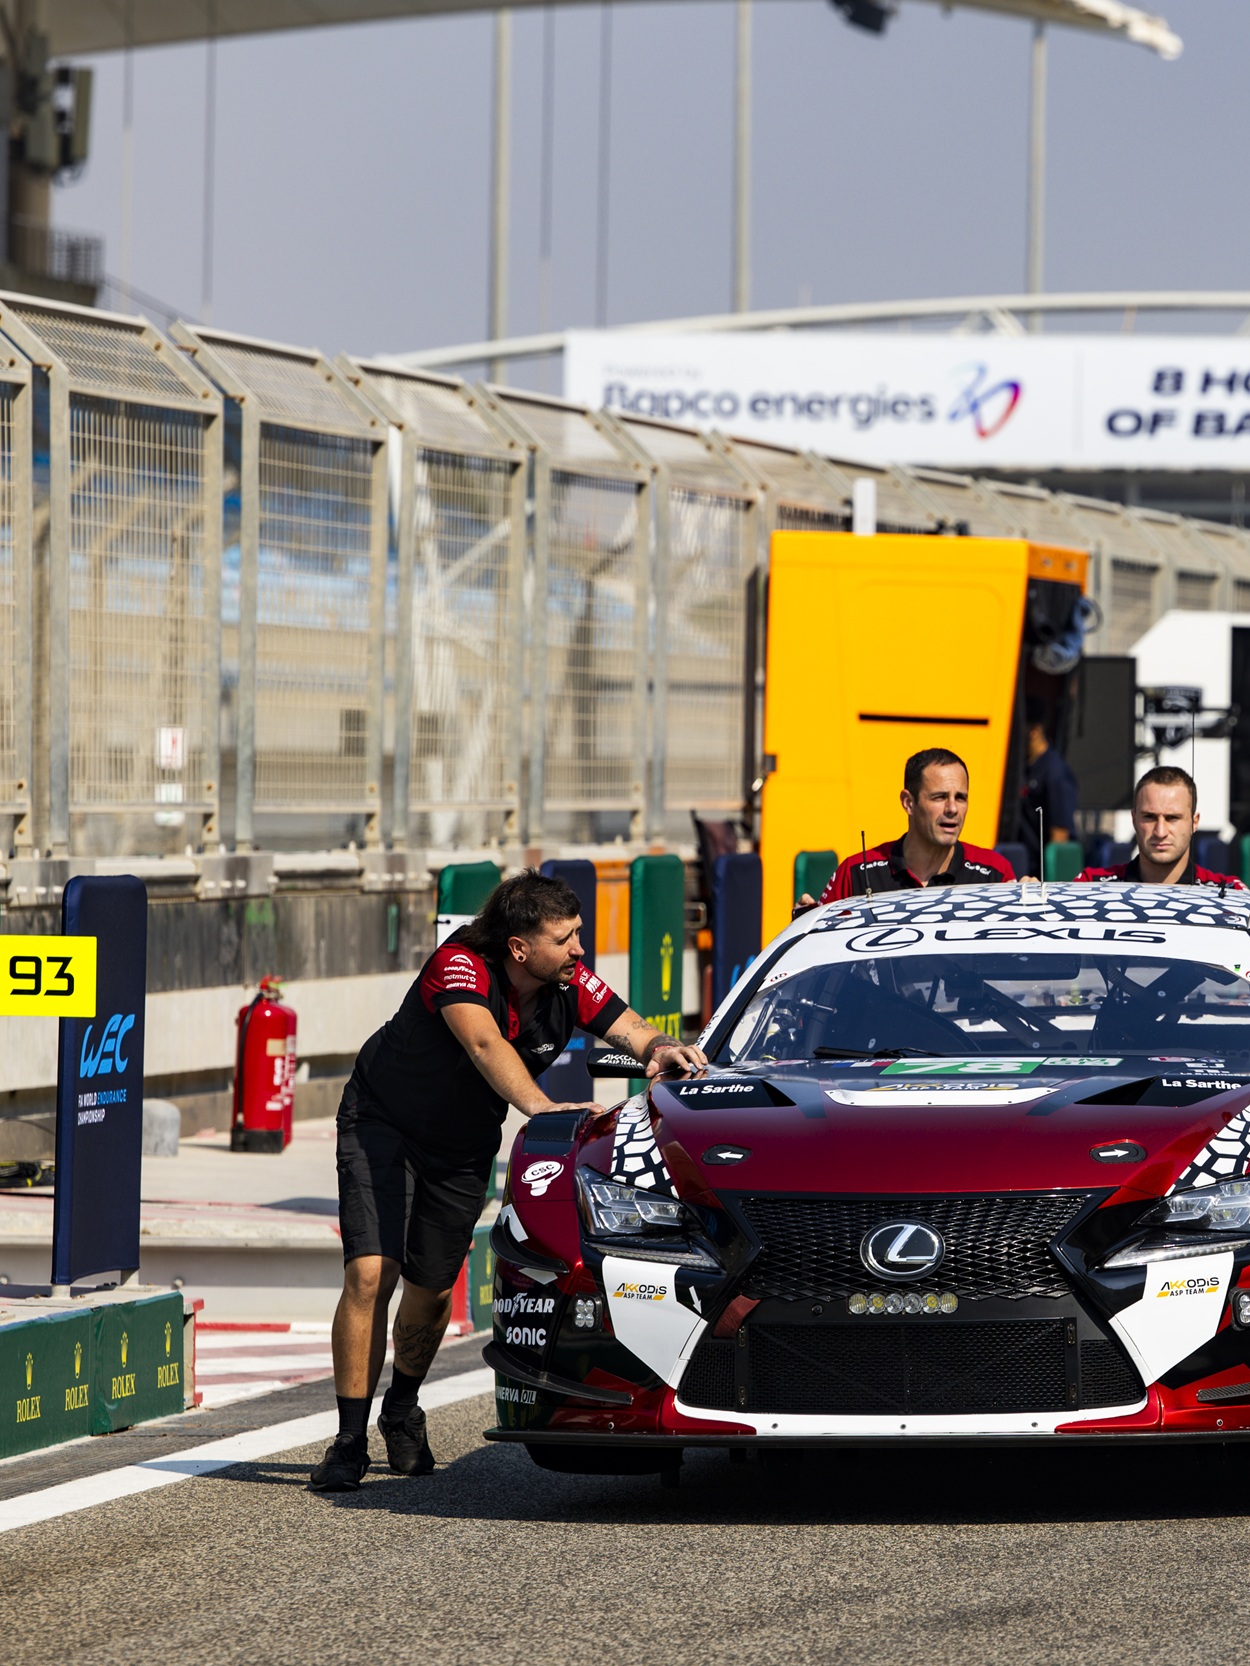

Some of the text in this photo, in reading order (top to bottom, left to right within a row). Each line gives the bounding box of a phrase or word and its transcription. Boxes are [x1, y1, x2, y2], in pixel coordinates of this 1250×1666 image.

[1152, 368, 1184, 396] 8
[603, 382, 935, 431] Bapco energies
[1105, 409, 1175, 438] OF
[934, 927, 1167, 944] LEXUS
[8, 955, 76, 997] 93
[79, 1013, 136, 1078] WEC
[896, 1061, 1023, 1074] 78
[679, 1083, 755, 1096] La Sarthe
[1161, 1078, 1242, 1090] La Sarthe
[84, 1092, 97, 1107] WORLD
[97, 1088, 127, 1106] ENDURANCE
[531, 1164, 555, 1176] CSC
[492, 1296, 555, 1315] OODYEAR
[506, 1326, 547, 1346] SONIC
[111, 1373, 136, 1400] ROLEX
[157, 1362, 180, 1389] ROLEX
[65, 1384, 89, 1411] ROLEX
[521, 1390, 536, 1404] OIL
[16, 1395, 41, 1424] ROLEX
